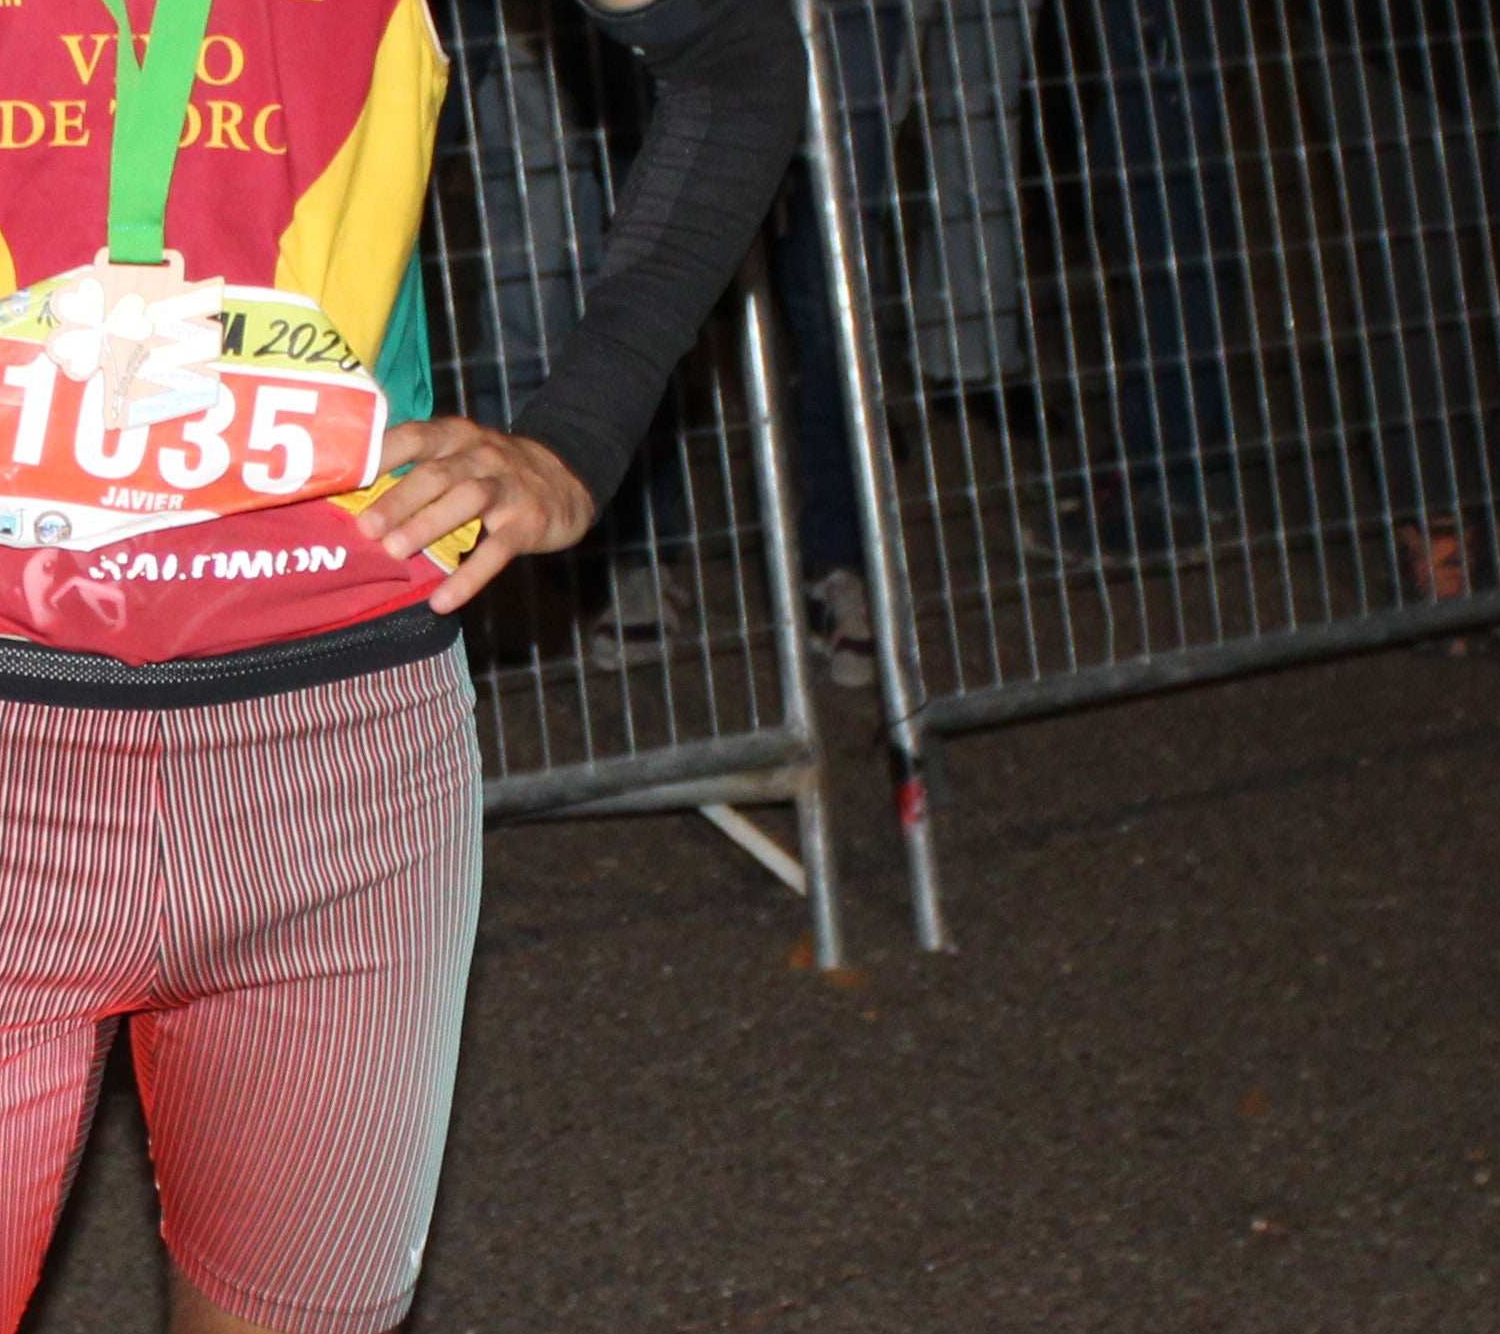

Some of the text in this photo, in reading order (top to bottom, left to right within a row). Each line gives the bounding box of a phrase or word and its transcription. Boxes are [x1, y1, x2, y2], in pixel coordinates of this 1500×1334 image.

[60, 34, 245, 85] VO
[3, 352, 319, 495] 1035
[100, 486, 185, 511] JAVIER
